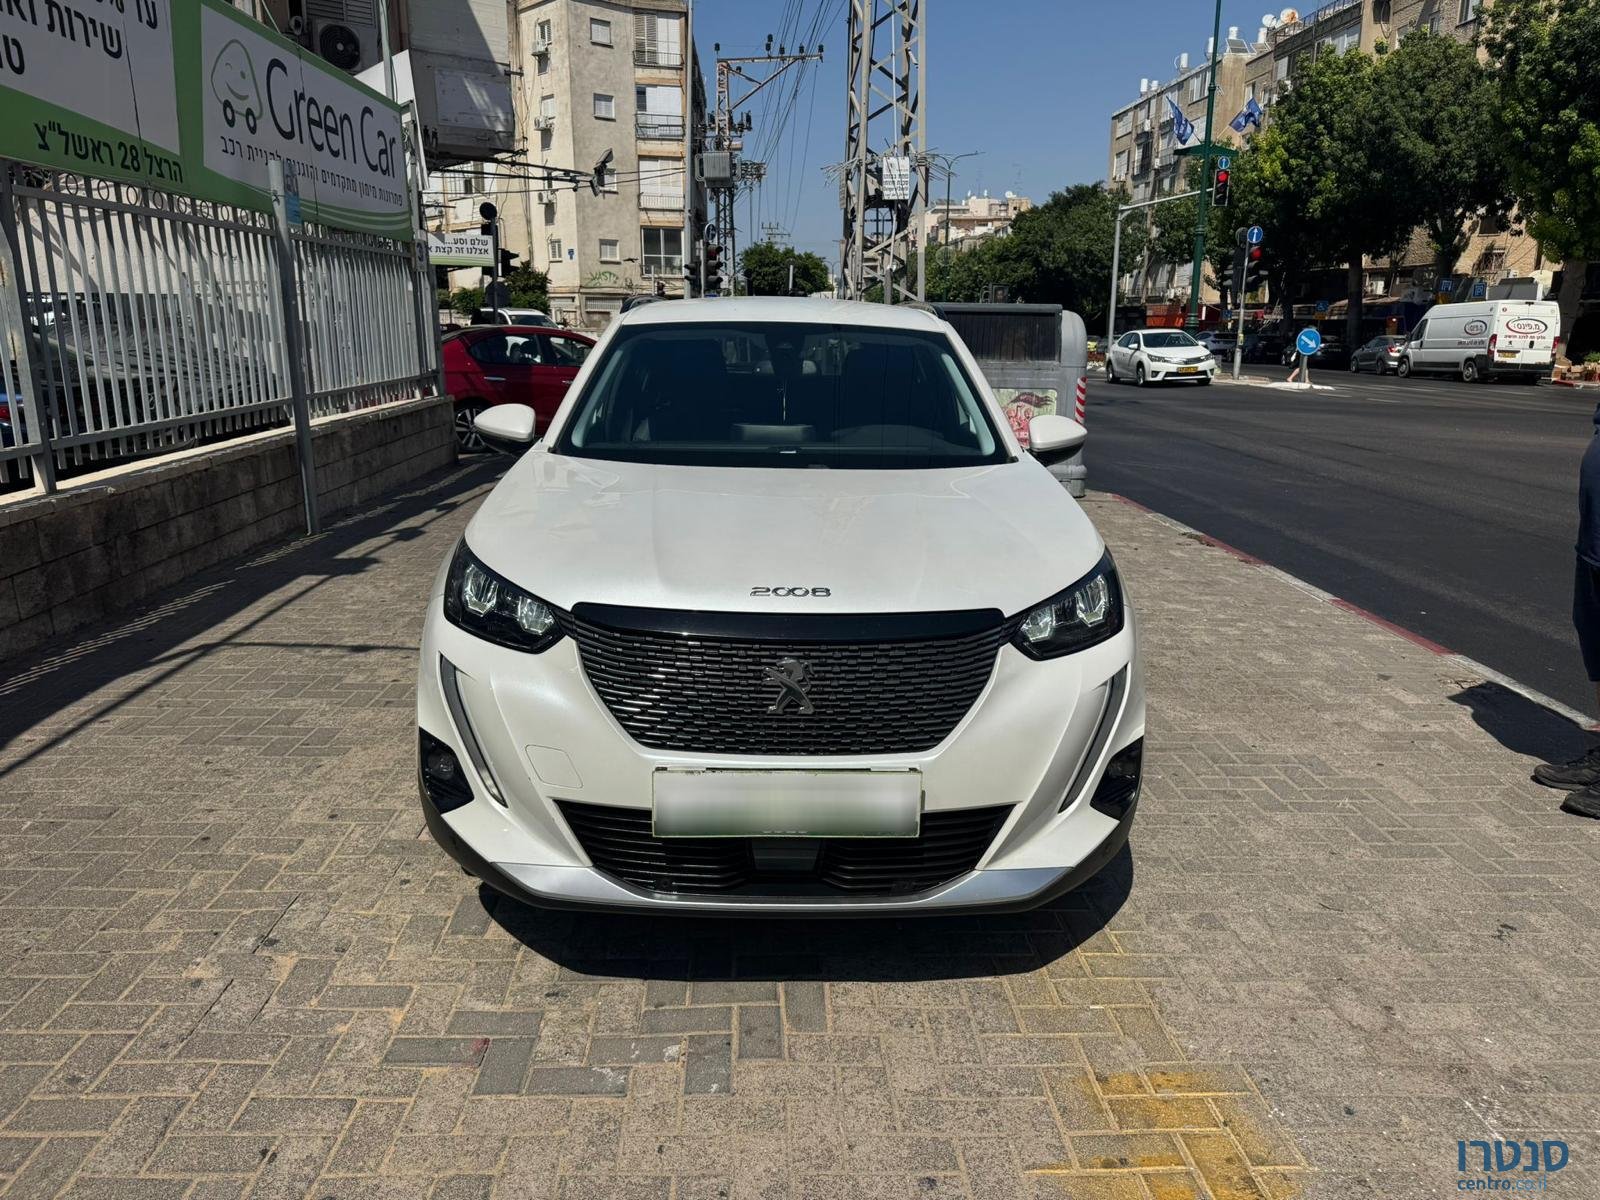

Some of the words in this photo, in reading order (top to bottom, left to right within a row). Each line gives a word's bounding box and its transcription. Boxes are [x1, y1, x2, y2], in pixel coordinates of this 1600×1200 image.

[45, 0, 123, 59] שירות
[266, 57, 357, 165] Green
[360, 105, 396, 178] Car
[117, 141, 141, 173] 28
[220, 135, 243, 159] רכב
[143, 146, 183, 184] הרצל
[321, 168, 357, 194] מתקדמים
[359, 181, 377, 199] מימון
[435, 245, 453, 255] קצת
[455, 246, 465, 254] זה
[466, 246, 489, 255] אצלנו
[470, 237, 489, 246] שלם
[749, 586, 832, 598] 2008
